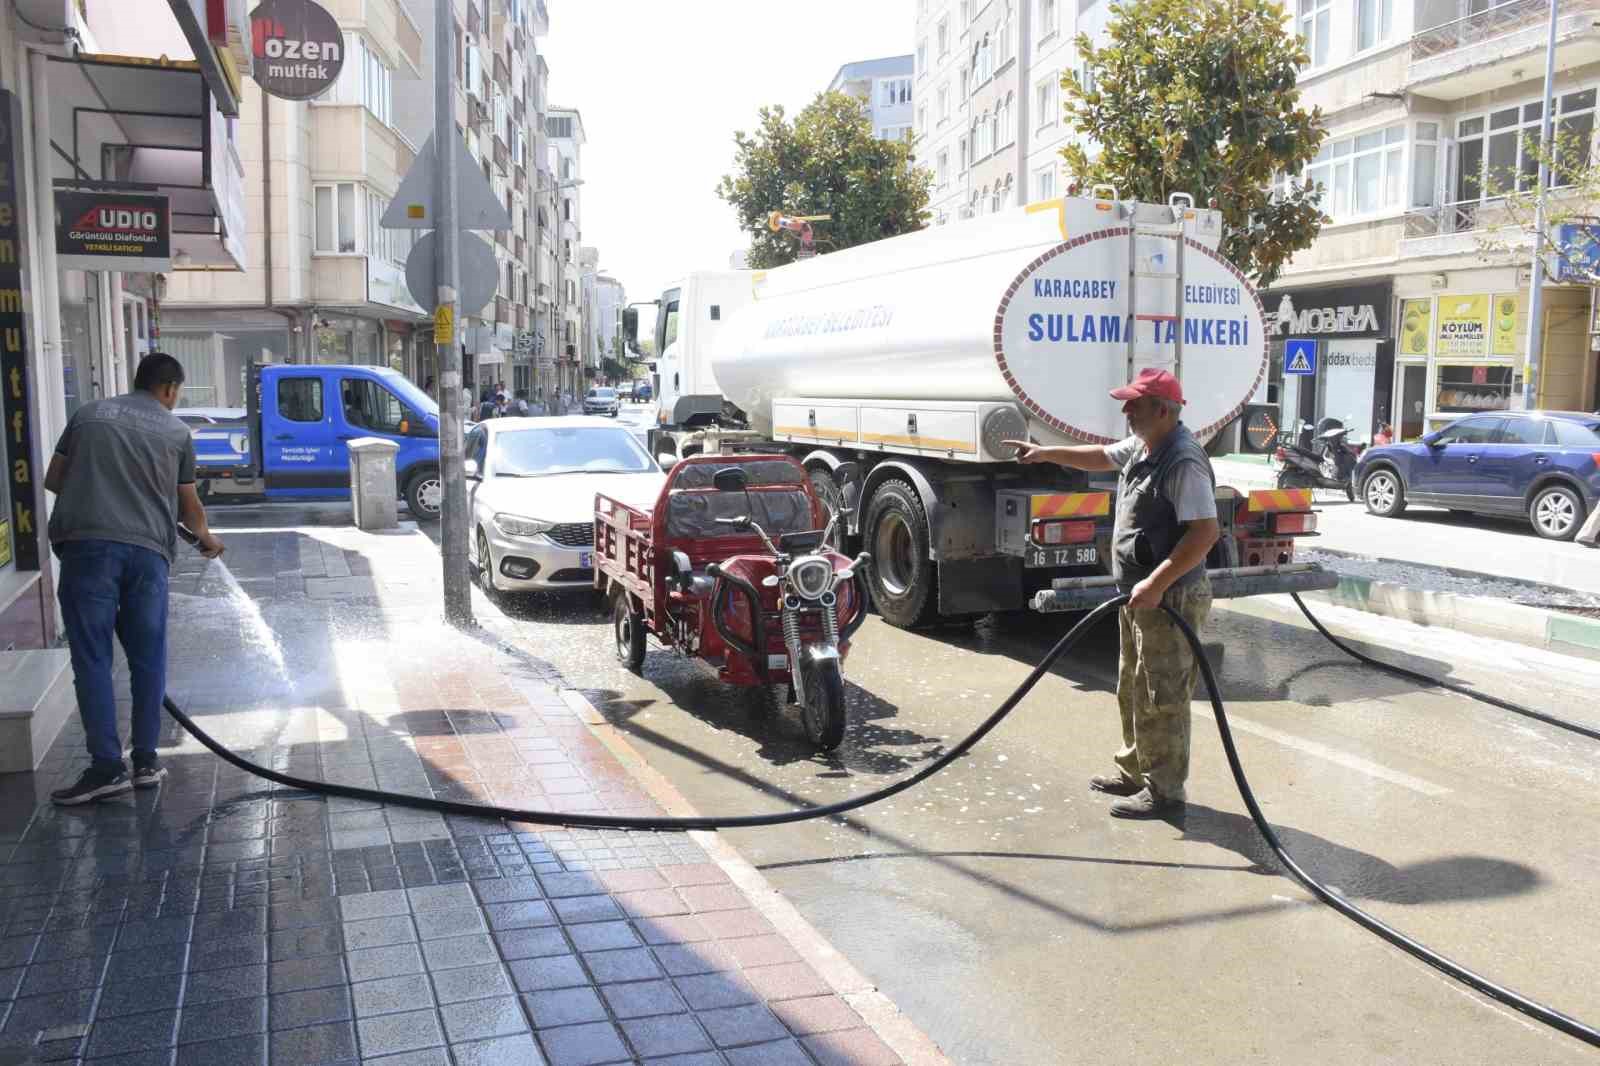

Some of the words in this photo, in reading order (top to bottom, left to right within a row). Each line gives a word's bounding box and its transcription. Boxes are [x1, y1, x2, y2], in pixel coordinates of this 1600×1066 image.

[269, 63, 328, 79] mutfak
[72, 206, 158, 231] AUDIO
[1034, 278, 1116, 300] KARACABEY
[1184, 284, 1241, 305] ELEDİYESİ
[1033, 551, 1046, 566] 16
[1055, 550, 1069, 563] TZ
[1076, 548, 1096, 563] 580
